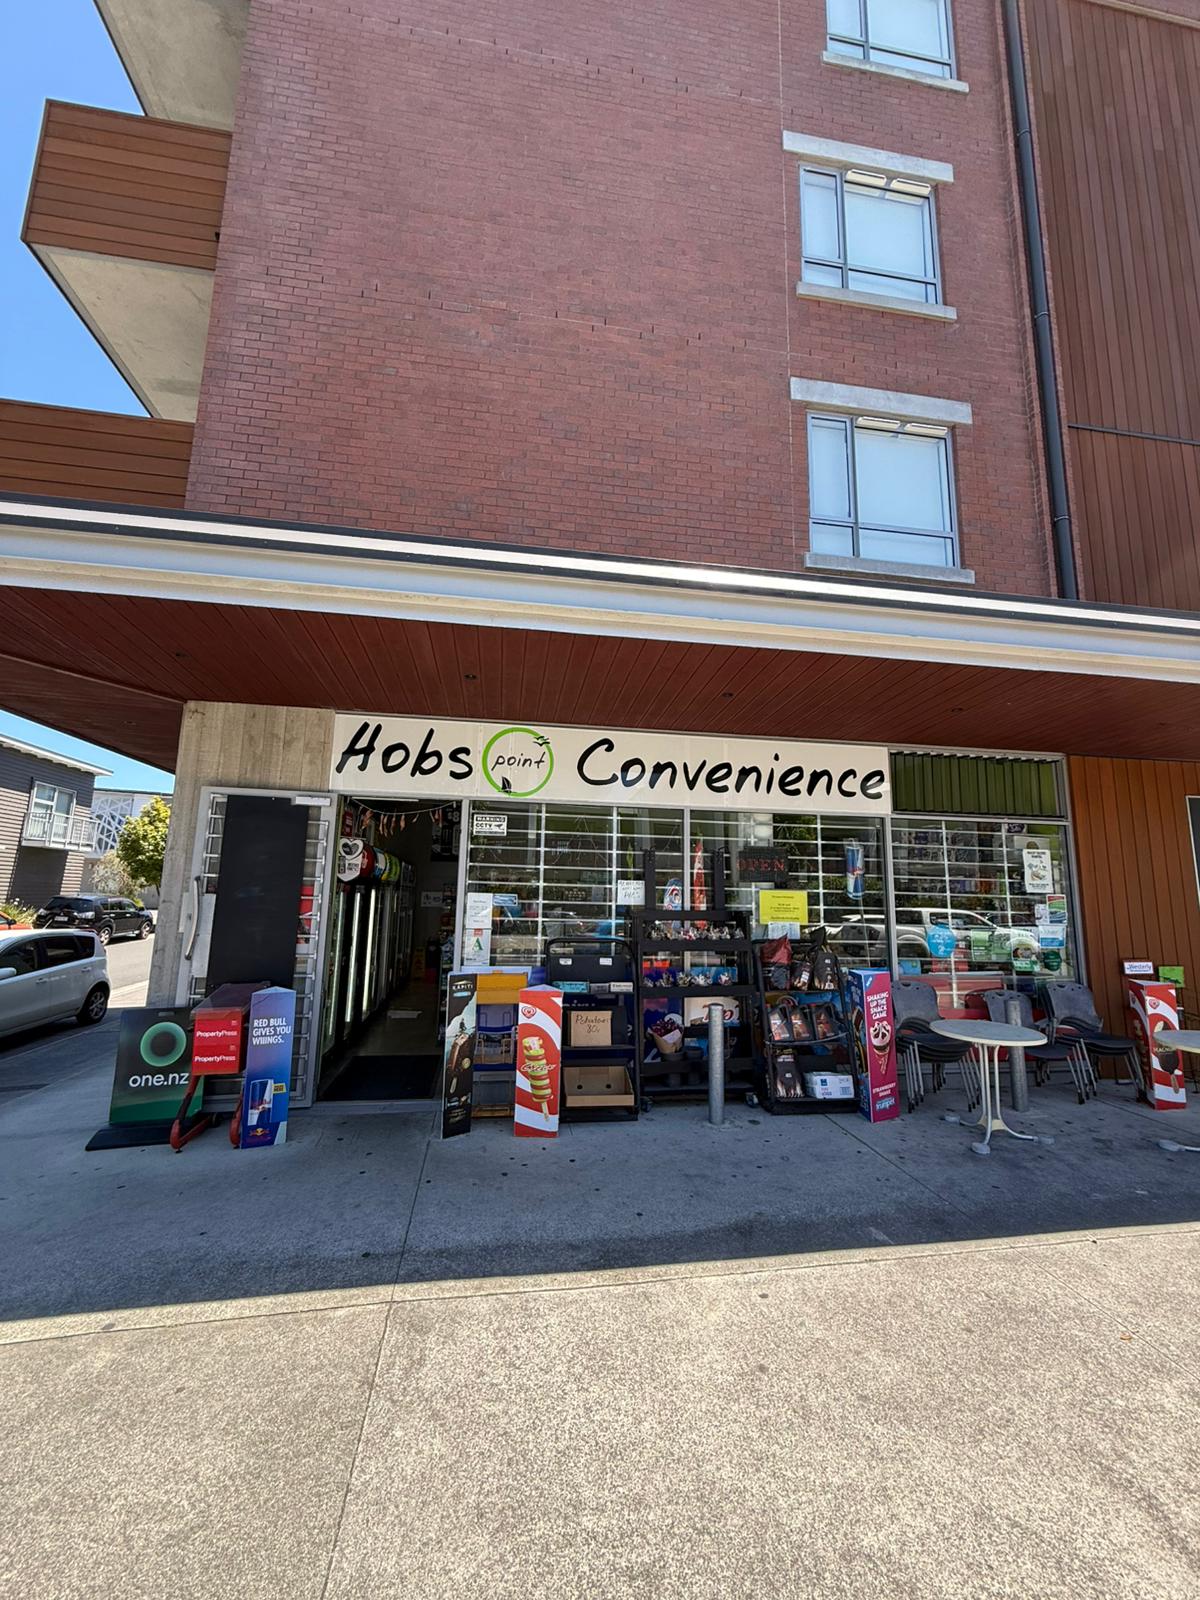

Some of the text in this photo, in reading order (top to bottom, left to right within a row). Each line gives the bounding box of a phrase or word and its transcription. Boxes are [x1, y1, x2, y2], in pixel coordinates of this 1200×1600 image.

[336, 721, 885, 799] Hobs point Convenience
[736, 858, 785, 872] OPEN
[866, 991, 889, 1002] SHAKING
[870, 1005, 888, 1015] SNACK
[872, 1012, 887, 1020] GAME
[253, 1018, 287, 1028] RED BULL
[196, 1030, 238, 1038] PropertyPress
[252, 1026, 291, 1037] GIVES YOU
[194, 1055, 236, 1063] PropertyPress
[128, 1072, 190, 1087] one.nz
